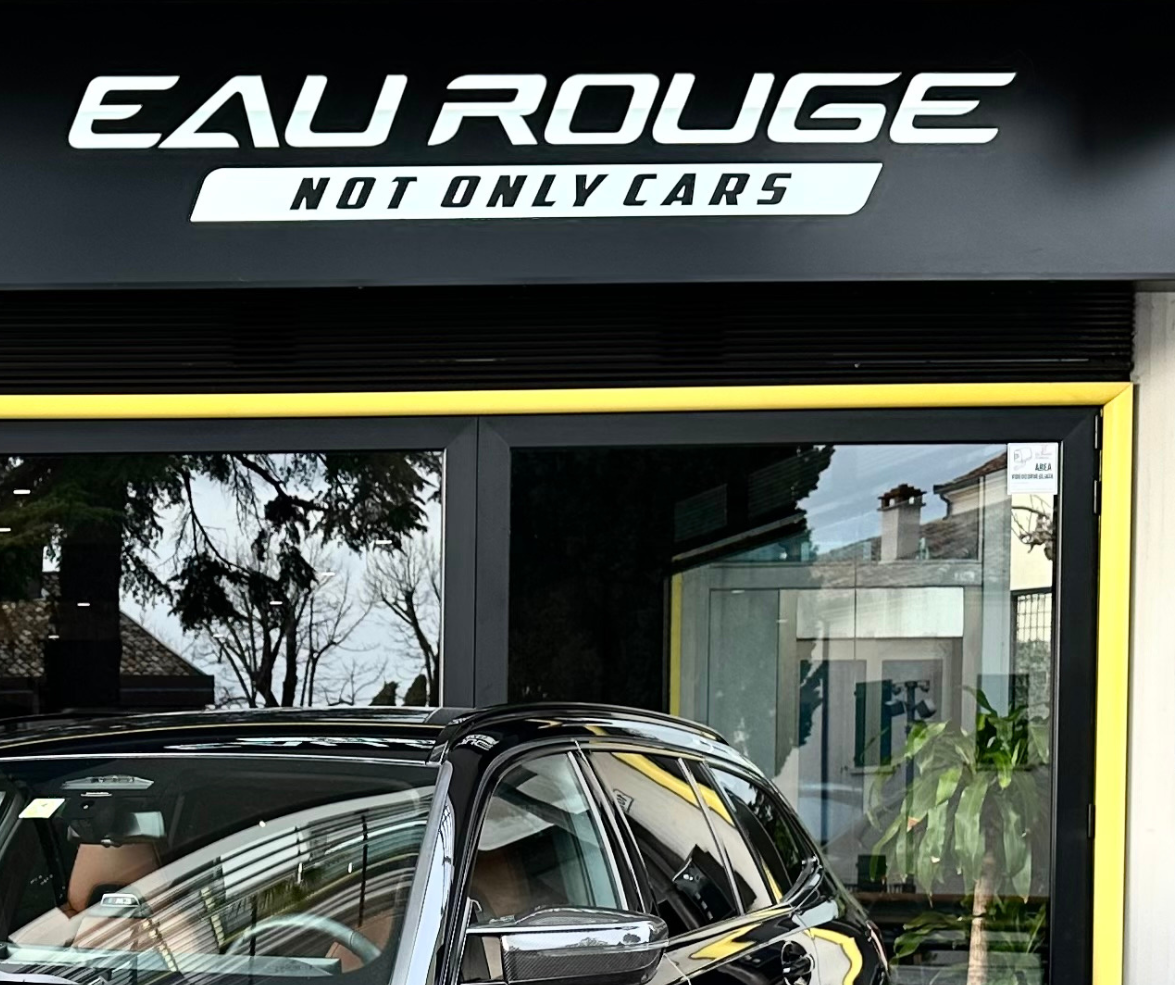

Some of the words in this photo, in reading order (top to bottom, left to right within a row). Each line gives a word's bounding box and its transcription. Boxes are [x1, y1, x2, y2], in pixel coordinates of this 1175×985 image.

[68, 75, 407, 149] EAU
[428, 72, 1016, 145] ROUGE
[290, 177, 417, 210] NOT
[441, 174, 607, 208] ONLY
[623, 173, 791, 206] CARS
